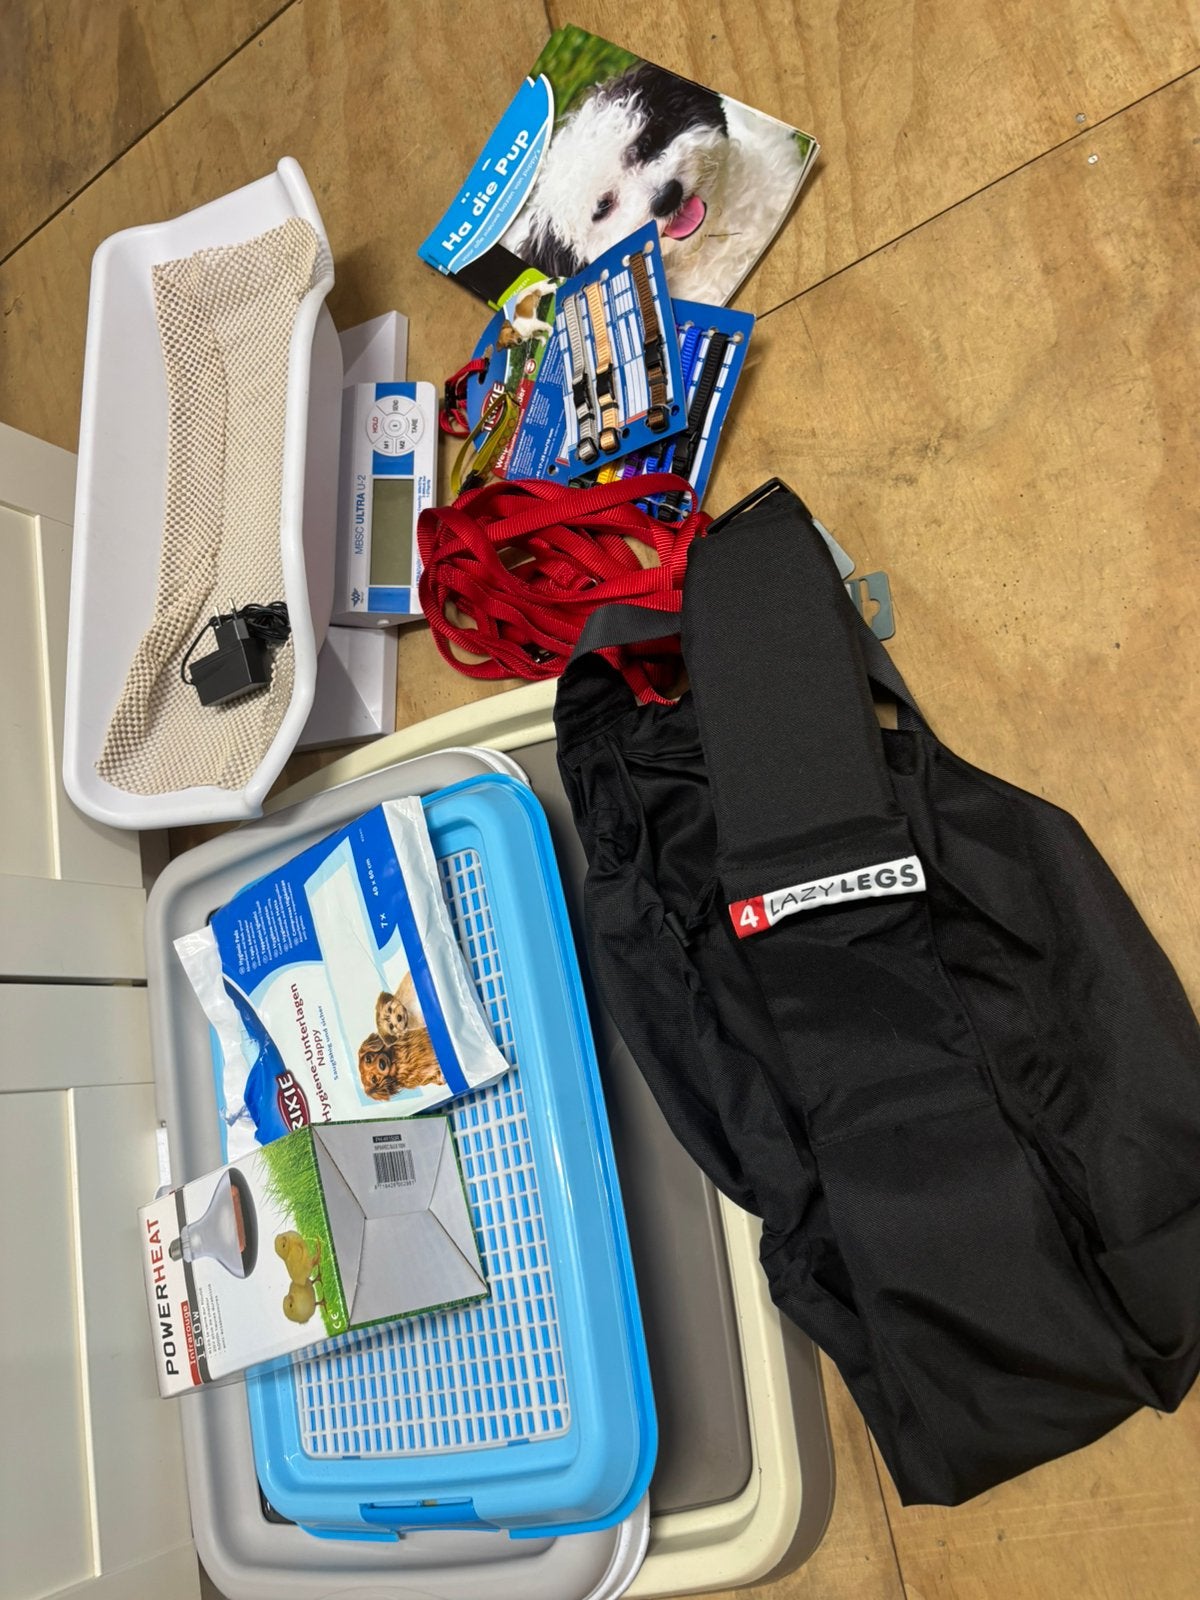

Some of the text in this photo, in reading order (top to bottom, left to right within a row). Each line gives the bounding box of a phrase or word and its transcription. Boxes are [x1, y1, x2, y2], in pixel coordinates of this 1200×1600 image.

[442, 130, 528, 251] Ha die Pup
[474, 237, 484, 249] alle
[483, 213, 500, 237] nieuwe
[498, 191, 515, 212] bazen
[514, 177, 524, 190] van
[522, 149, 543, 177] puppy's
[384, 441, 389, 449] M1
[399, 440, 405, 449] M2
[354, 474, 366, 554] MBSC ULTRA U-2
[366, 858, 372, 869] cm
[368, 869, 375, 880] 60
[372, 886, 379, 896] 40
[740, 905, 758, 928] 4
[290, 983, 331, 1124] Hygiene-Unterlagen
[312, 1029, 325, 1066] Nappy
[279, 1074, 304, 1132] RIXIE
[146, 1218, 178, 1375] POWERHEAT
[181, 1304, 197, 1366] Infrarouge
